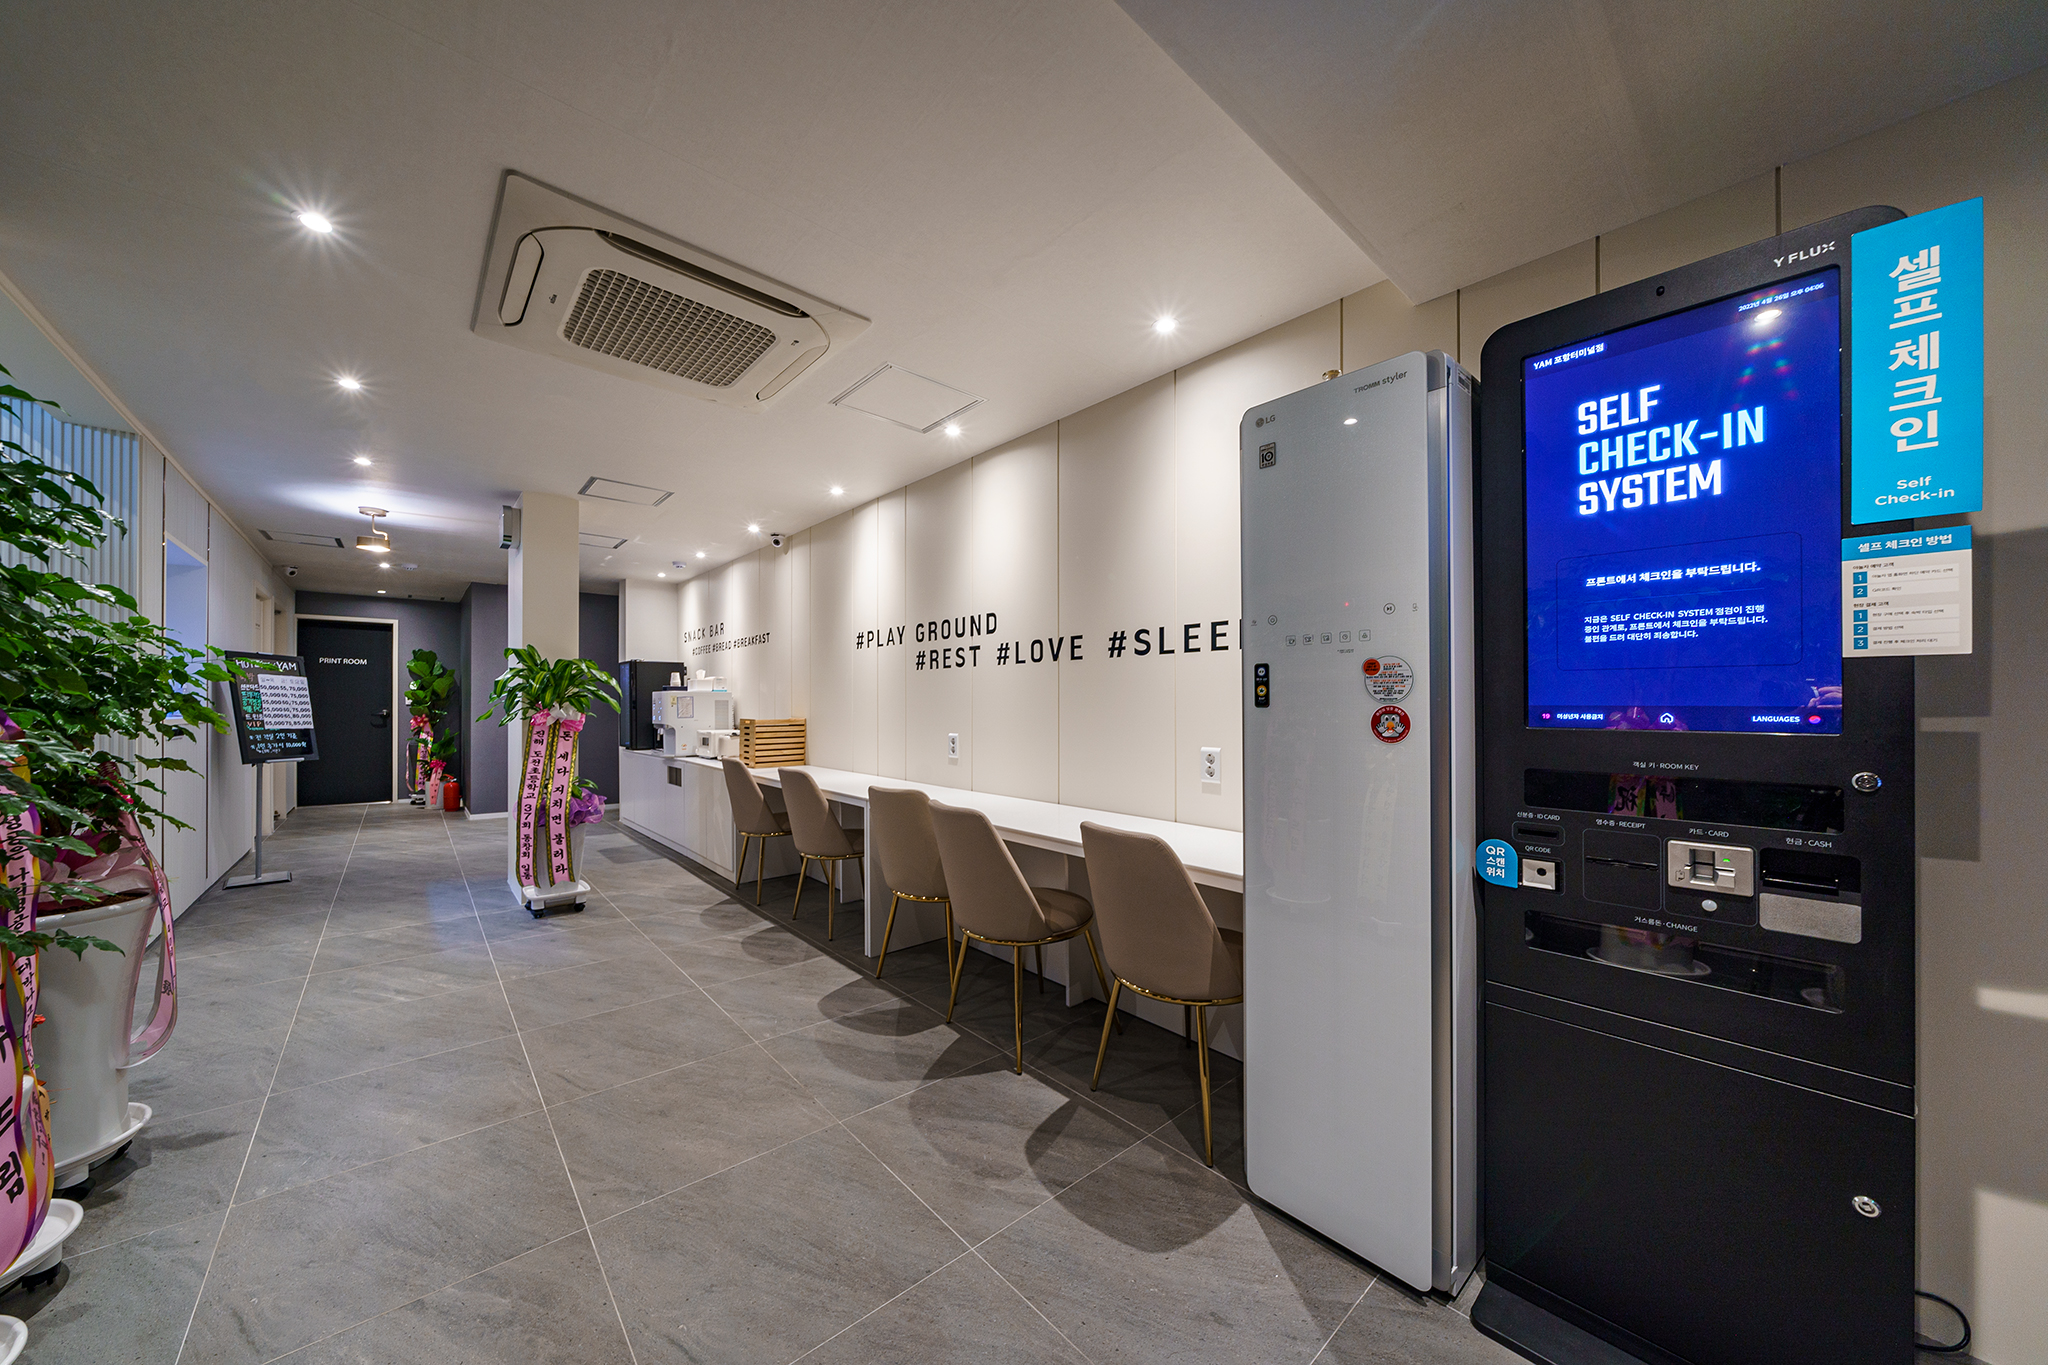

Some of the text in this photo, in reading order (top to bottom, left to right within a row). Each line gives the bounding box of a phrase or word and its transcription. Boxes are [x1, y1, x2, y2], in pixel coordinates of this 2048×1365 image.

[1773, 240, 1835, 268] Y FLUX
[1738, 301, 1760, 312] 2022년
[1761, 296, 1772, 305] 4월
[1533, 342, 1605, 370] YAM 포항터미널점
[1354, 371, 1408, 393] TROMM styler
[1578, 384, 1660, 435] SELF
[1265, 415, 1276, 424] LG
[1579, 405, 1764, 475] CHECK-IN
[1579, 459, 1722, 516] SYSTEM
[1896, 475, 1932, 490] Self
[1874, 487, 1955, 506] Check-in
[1858, 534, 1952, 553] 셀프 체크인 방법
[1586, 561, 1762, 587] 프론트에서 체크인을 부탁드립니다.
[1584, 604, 1765, 624] 지금은 SELF CHECK-IN SYSTEM 점검이 진행
[684, 622, 725, 643] SNACK BAR
[856, 611, 999, 651] #PLAY GROUND
[1584, 615, 1769, 633] 중인 관계로, 프론트에서 체크인을 부탁드립니다.
[692, 632, 770, 656] #COFFEE #BREAD #BREAKFAST
[915, 618, 1242, 670] #REST #LOVE #SLEE
[1584, 630, 1699, 643] 불편을 드려 대단히 죄송합니다.
[276, 661, 297, 671] YAM
[551, 730, 573, 875] 돈 세다 지치면 불러라
[1596, 818, 1646, 829] 영수증 RECEIPT
[1708, 829, 1729, 838] CARD
[1785, 837, 1832, 848] 현금 CASH
[521, 833, 532, 859] 동창회
[1486, 846, 1505, 857] QR
[521, 864, 533, 880] 일동
[1486, 857, 1505, 868] 스캔
[1486, 867, 1505, 879] 위치
[1634, 916, 1698, 933] 거스름돈 CHANGE
